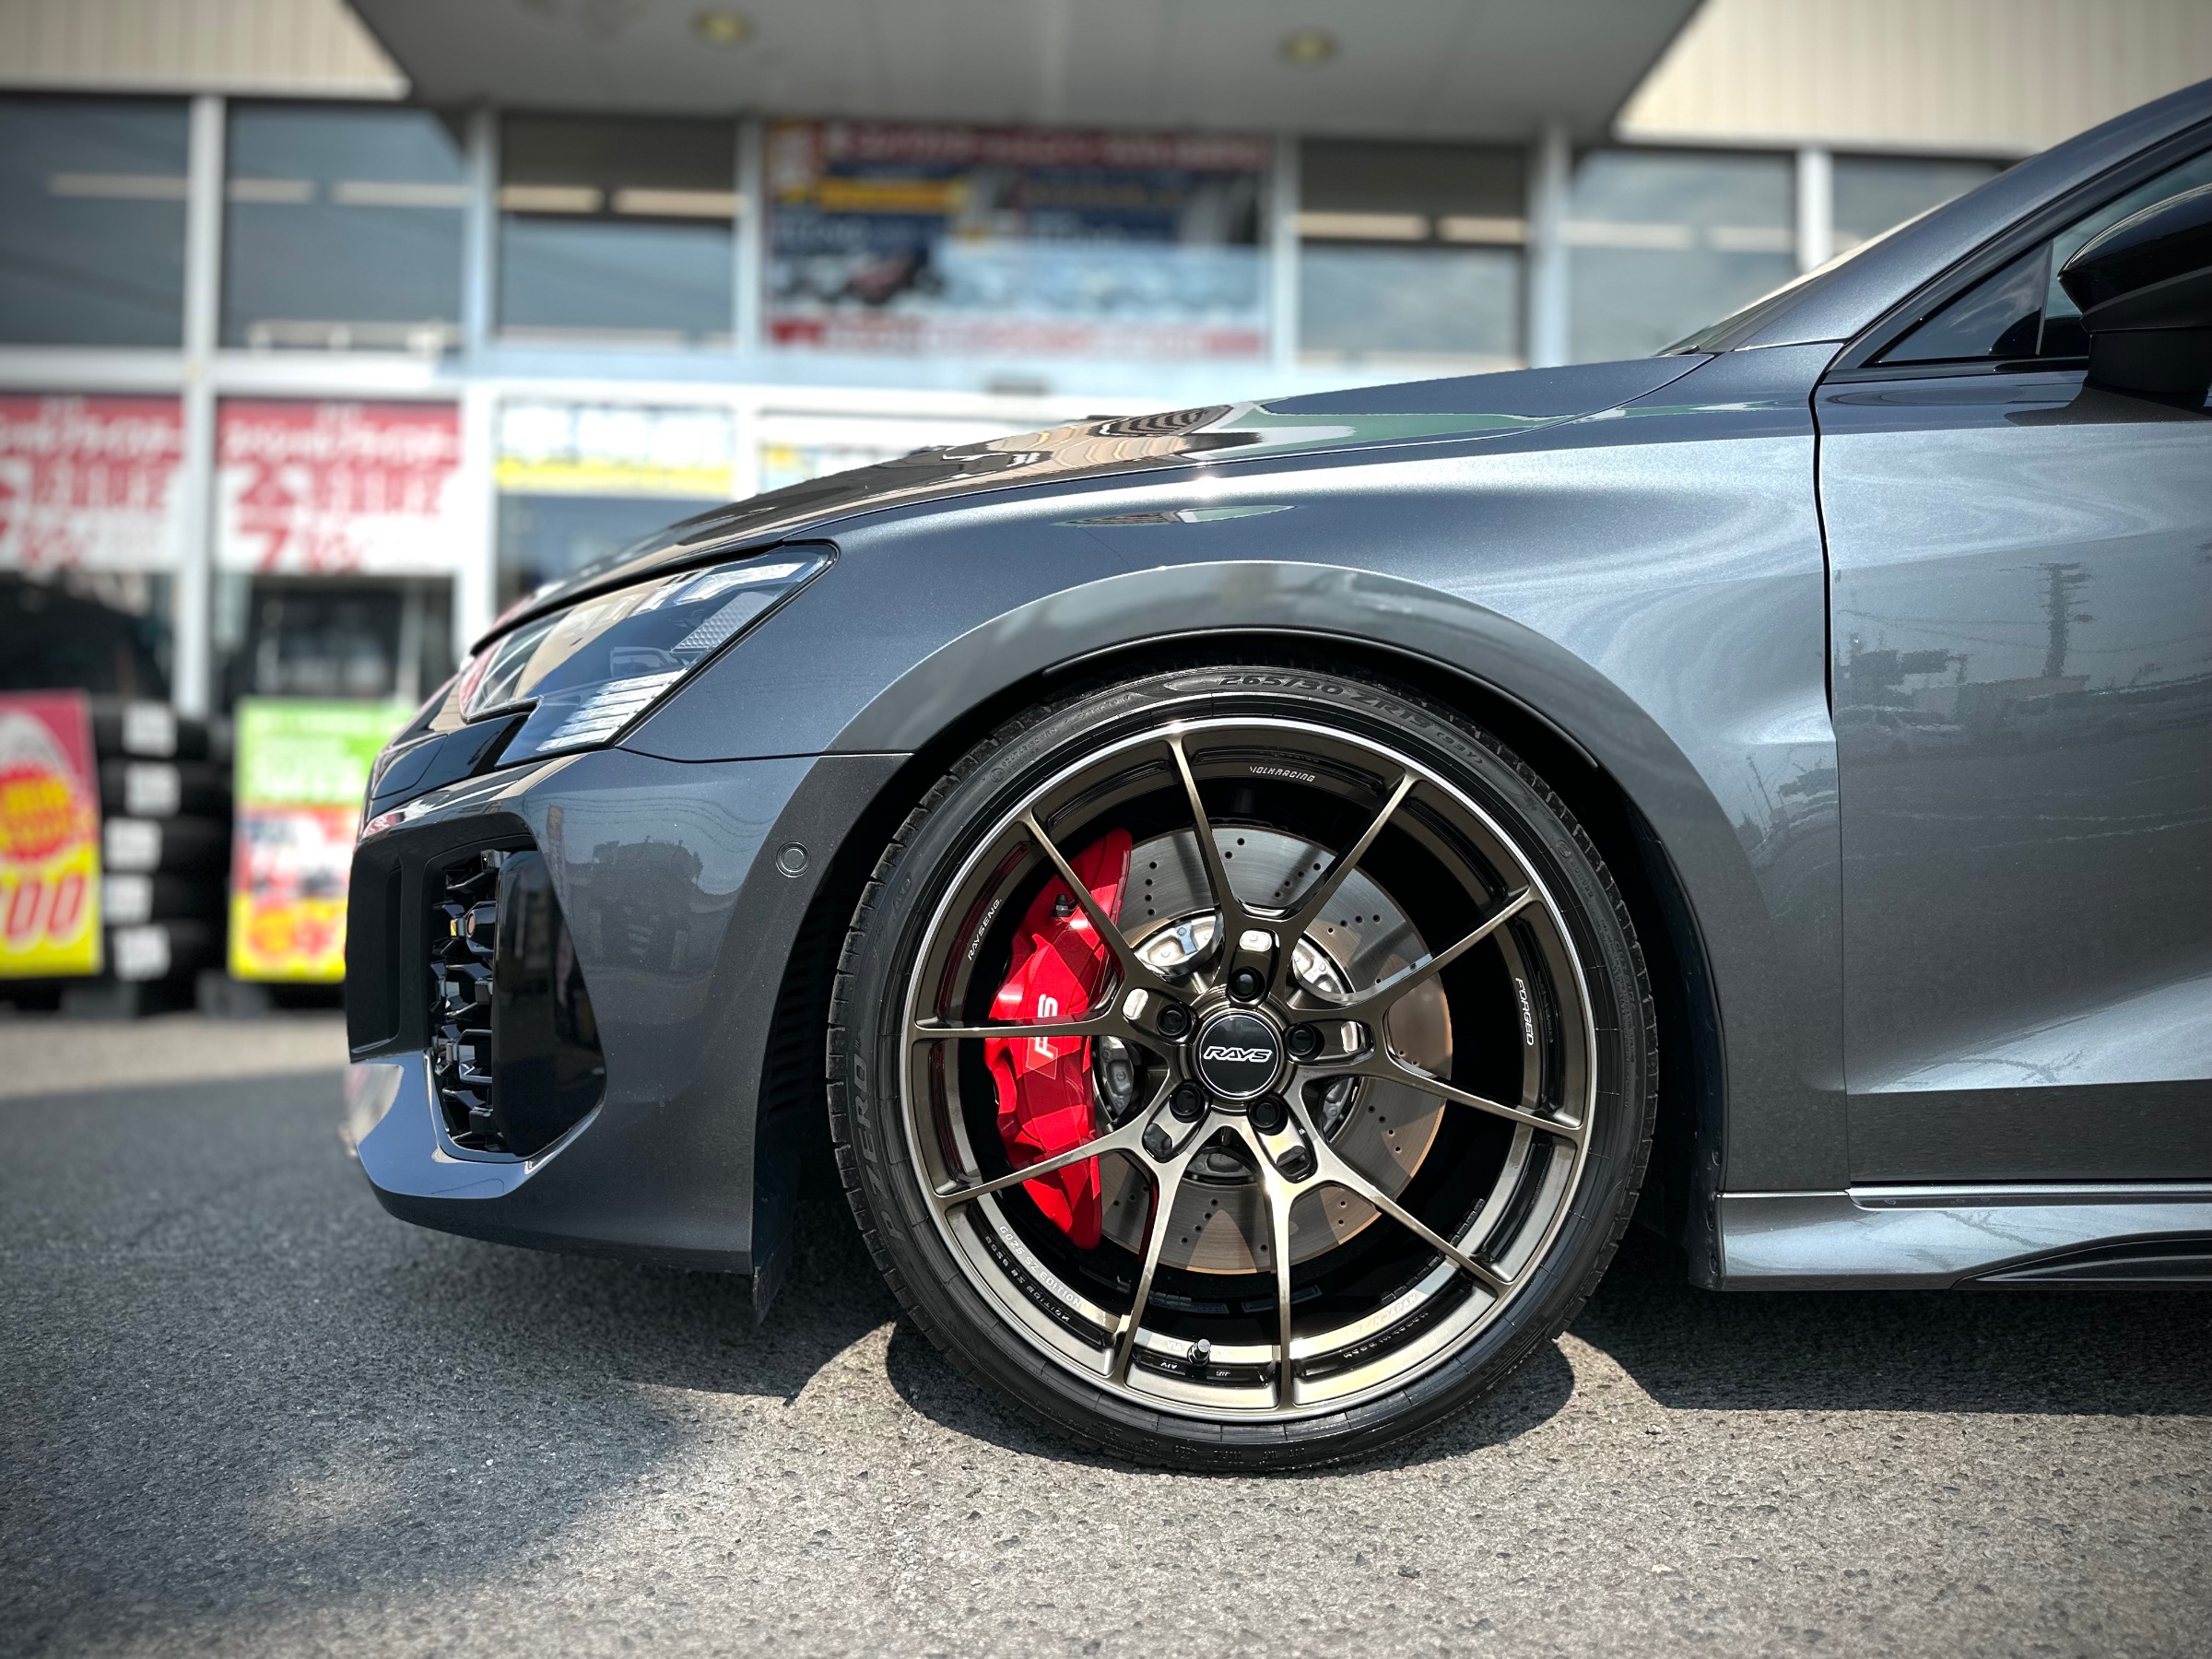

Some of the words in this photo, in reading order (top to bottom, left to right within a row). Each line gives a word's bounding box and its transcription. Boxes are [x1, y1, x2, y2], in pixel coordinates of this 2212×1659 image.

[1220, 675, 1344, 695] 265/30
[1515, 977, 1534, 1045] FORGED
[1203, 1046, 1273, 1063] RAYS
[853, 1053, 890, 1199] ZERO
[1024, 1256, 1040, 1272] SZ
[1039, 1271, 1081, 1308] EDITION
[1371, 1314, 1382, 1326] IN
[1382, 1292, 1417, 1319] JAPAN
